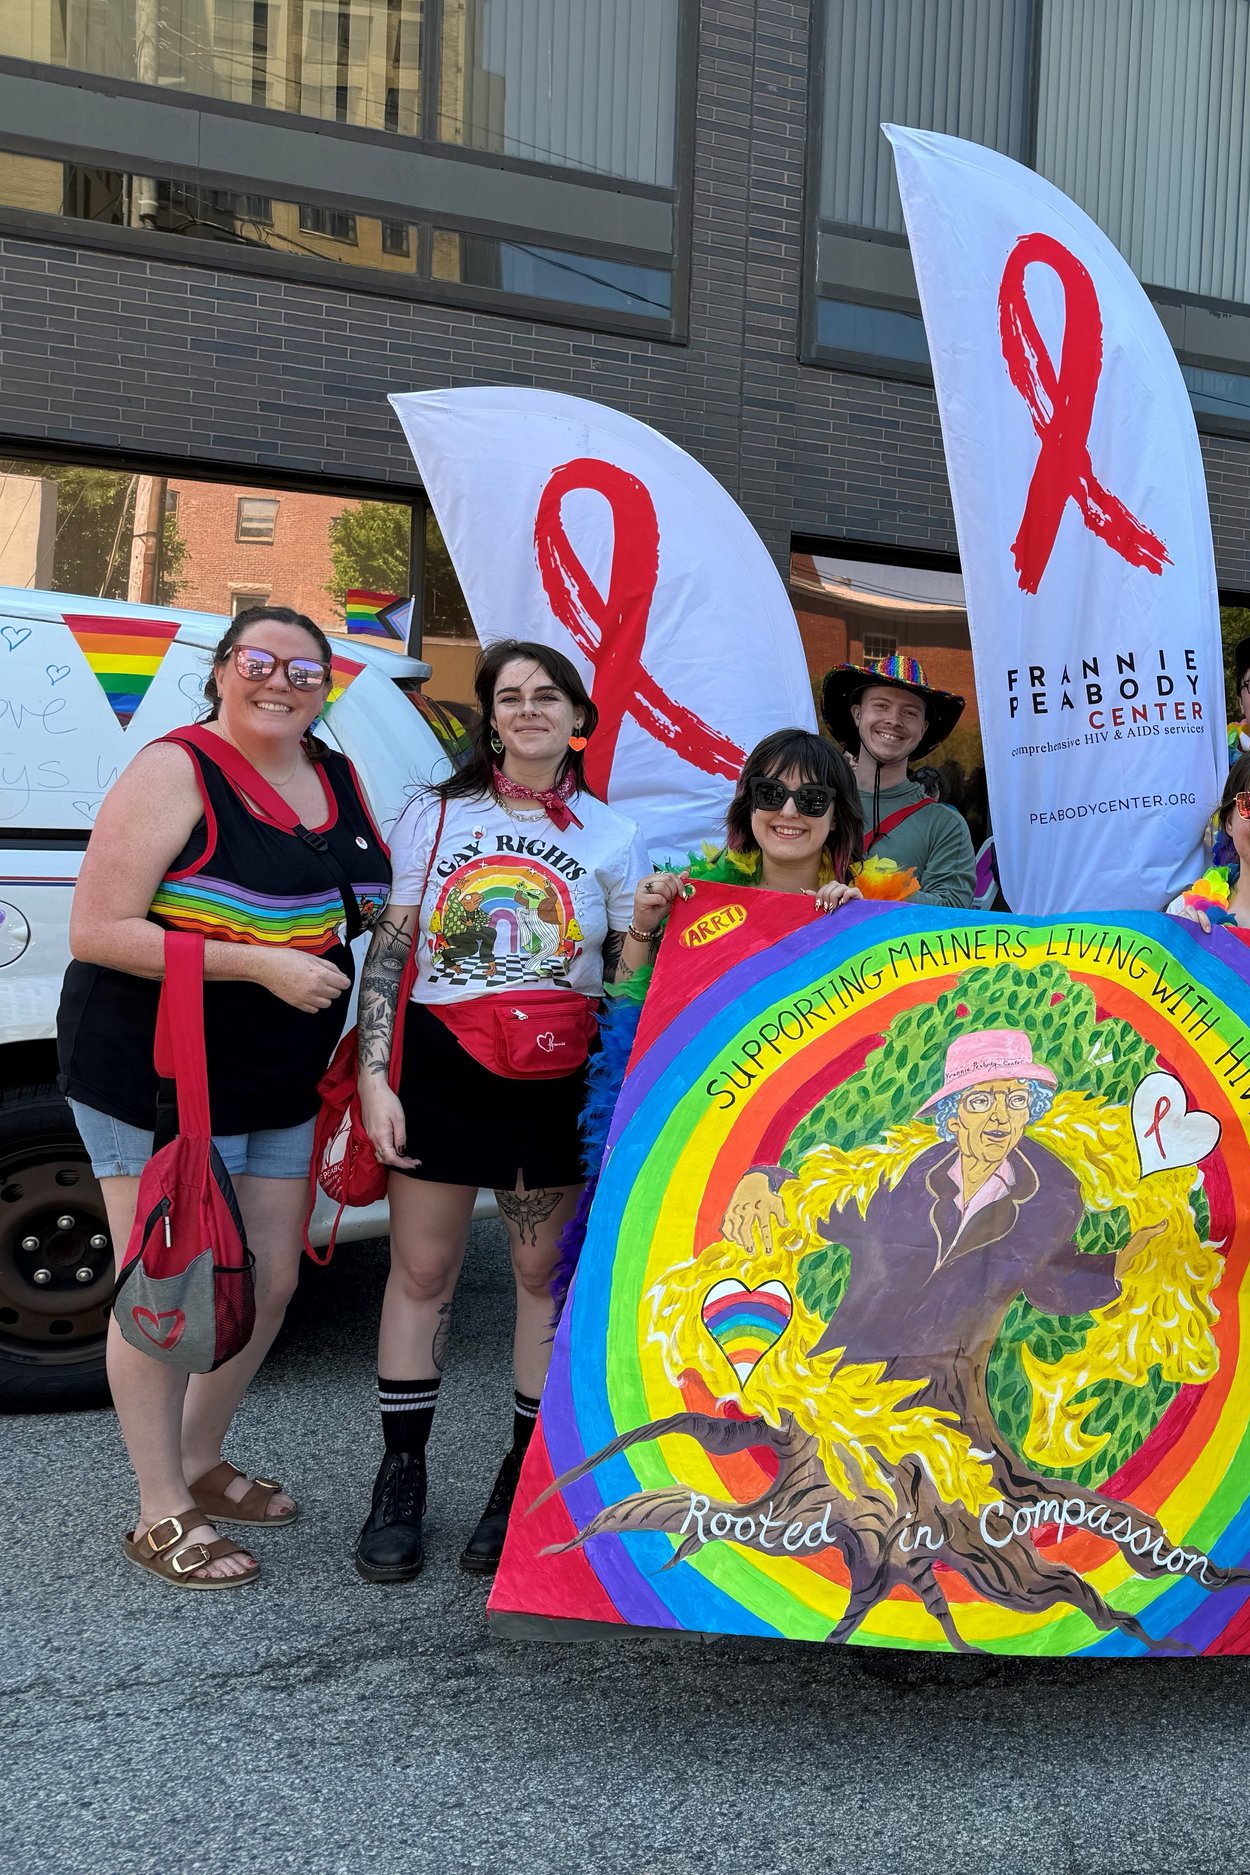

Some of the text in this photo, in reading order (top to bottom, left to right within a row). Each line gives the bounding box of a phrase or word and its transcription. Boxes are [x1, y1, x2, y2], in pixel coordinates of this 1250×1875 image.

[1007, 649, 1198, 692] FRANNIE
[1009, 674, 1199, 719] PEABODY
[1088, 701, 1204, 730] CENTER
[1011, 723, 1205, 758] comprehensive HIV & AIDS services
[1029, 792, 1196, 825] PEABODYCENTER.ORG
[436, 834, 588, 882] GAY RIGHTS
[687, 906, 744, 947] ARRT!
[706, 956, 884, 1110] SUPPORTING
[888, 929, 1031, 978] MAINERS
[1046, 926, 1153, 980] LIVING
[1151, 961, 1221, 1042] WITH
[679, 1491, 1216, 1585] Rooted in Compassion
